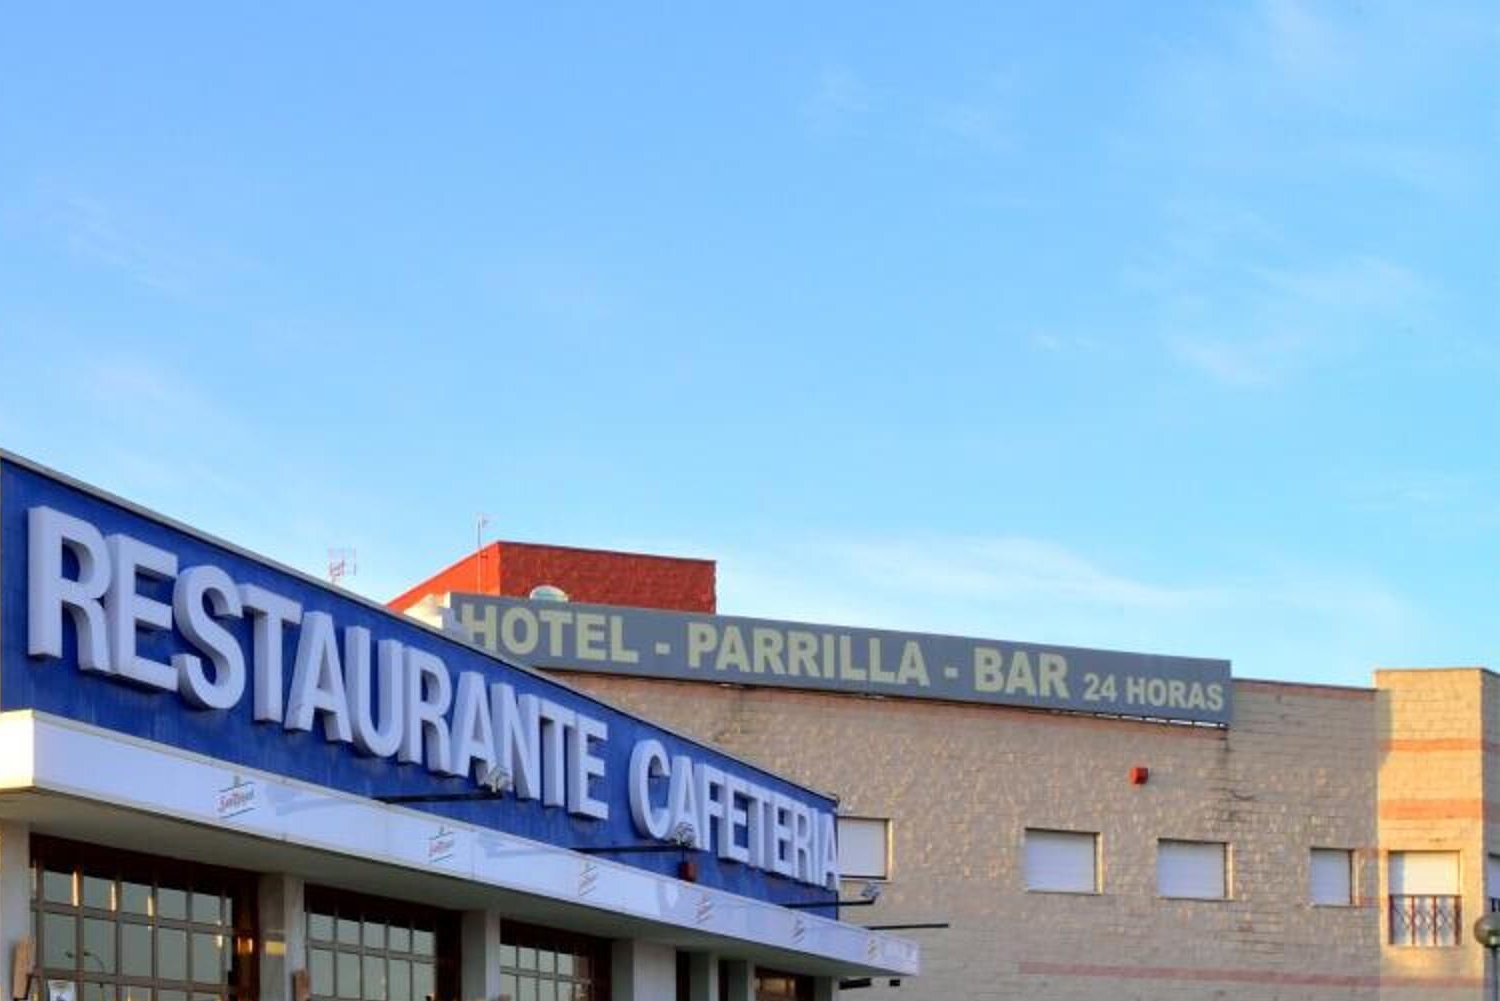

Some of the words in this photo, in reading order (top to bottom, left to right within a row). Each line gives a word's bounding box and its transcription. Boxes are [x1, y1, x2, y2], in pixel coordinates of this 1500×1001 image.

[27, 504, 609, 821] RESTAURANTE
[628, 738, 839, 891] CAFETERIA
[461, 603, 639, 663] HOTEL
[688, 622, 930, 687] PARRILLA
[973, 646, 1070, 699] BAR
[1083, 672, 1118, 702] 24
[1126, 677, 1225, 712] HORAS
